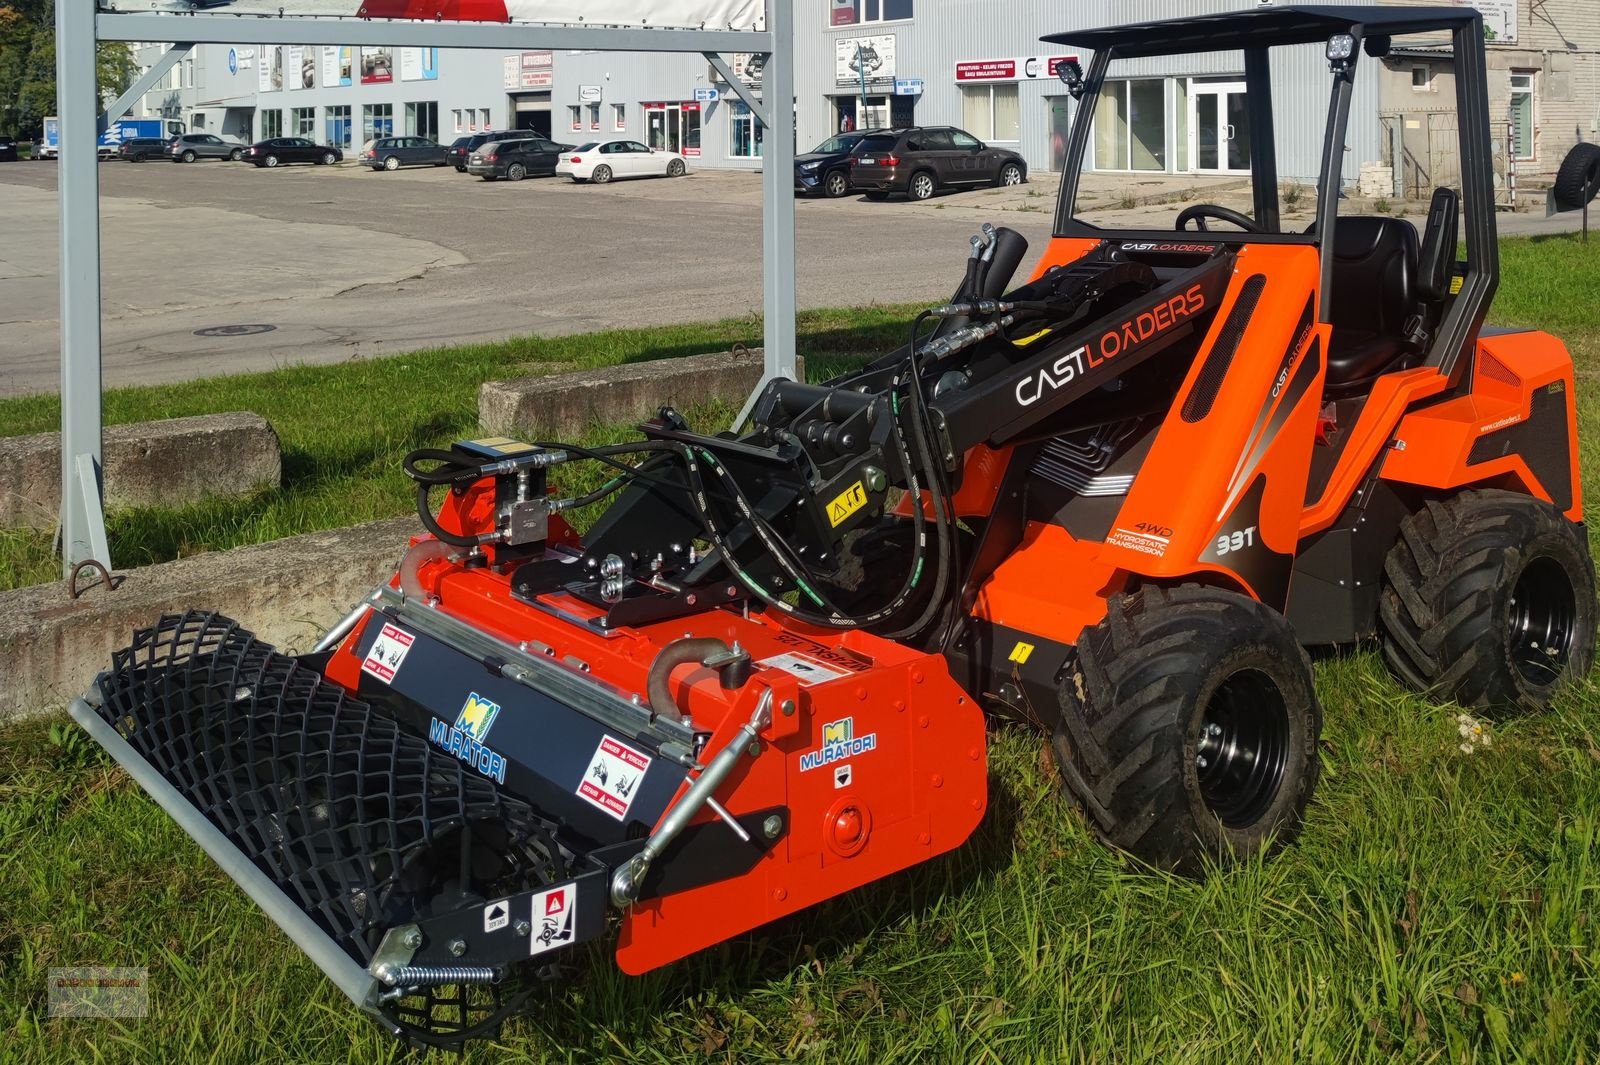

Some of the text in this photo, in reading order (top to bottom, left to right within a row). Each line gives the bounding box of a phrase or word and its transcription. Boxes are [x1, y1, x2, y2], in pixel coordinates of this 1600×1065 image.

[1121, 242, 1216, 253] CASTLOADERS
[1015, 284, 1205, 407] CASTLOADERS
[1134, 522, 1174, 538] 4WD
[1106, 536, 1165, 558] TRANSMISSION
[1113, 532, 1168, 551] HYDROSTATIC
[1216, 526, 1256, 557] 33T
[773, 634, 805, 647] 125
[429, 716, 507, 785] MURATORI
[602, 741, 620, 755] DANGER
[801, 733, 876, 771] MURATORI
